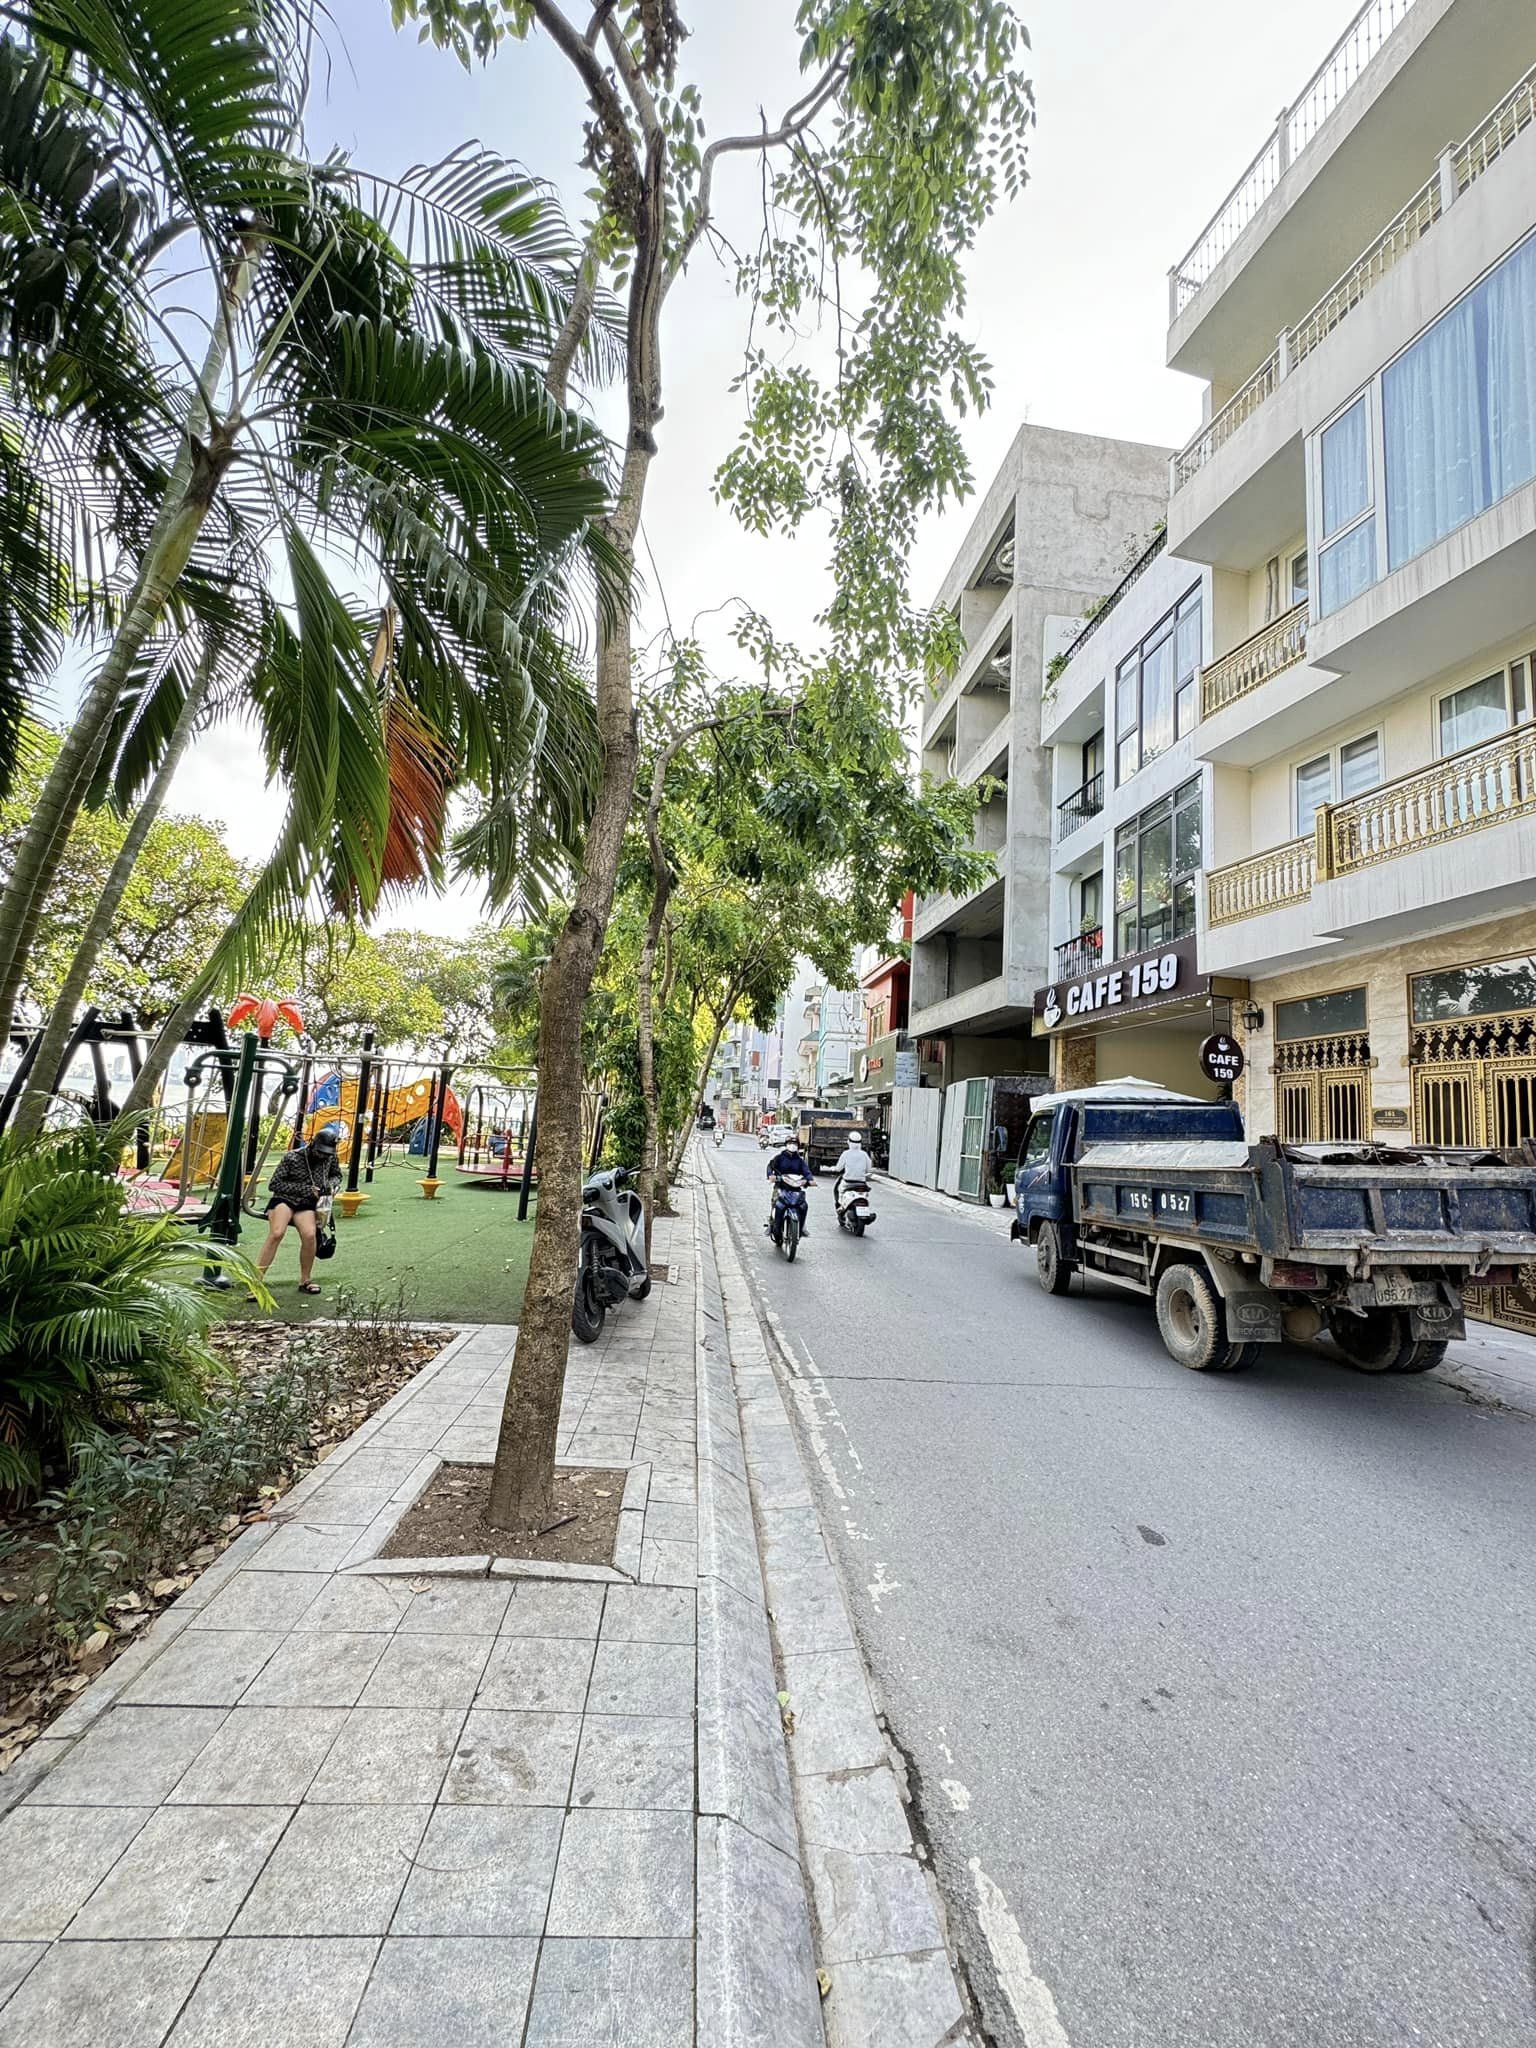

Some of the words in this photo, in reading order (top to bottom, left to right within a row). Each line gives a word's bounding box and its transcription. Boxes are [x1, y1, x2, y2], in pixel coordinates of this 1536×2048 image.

[1066, 970, 1124, 1017] CAFE
[1128, 953, 1179, 999] 159
[1208, 1053, 1240, 1066] CAFE
[1213, 1067, 1234, 1079] 159
[1422, 1307, 1448, 1319] KIA
